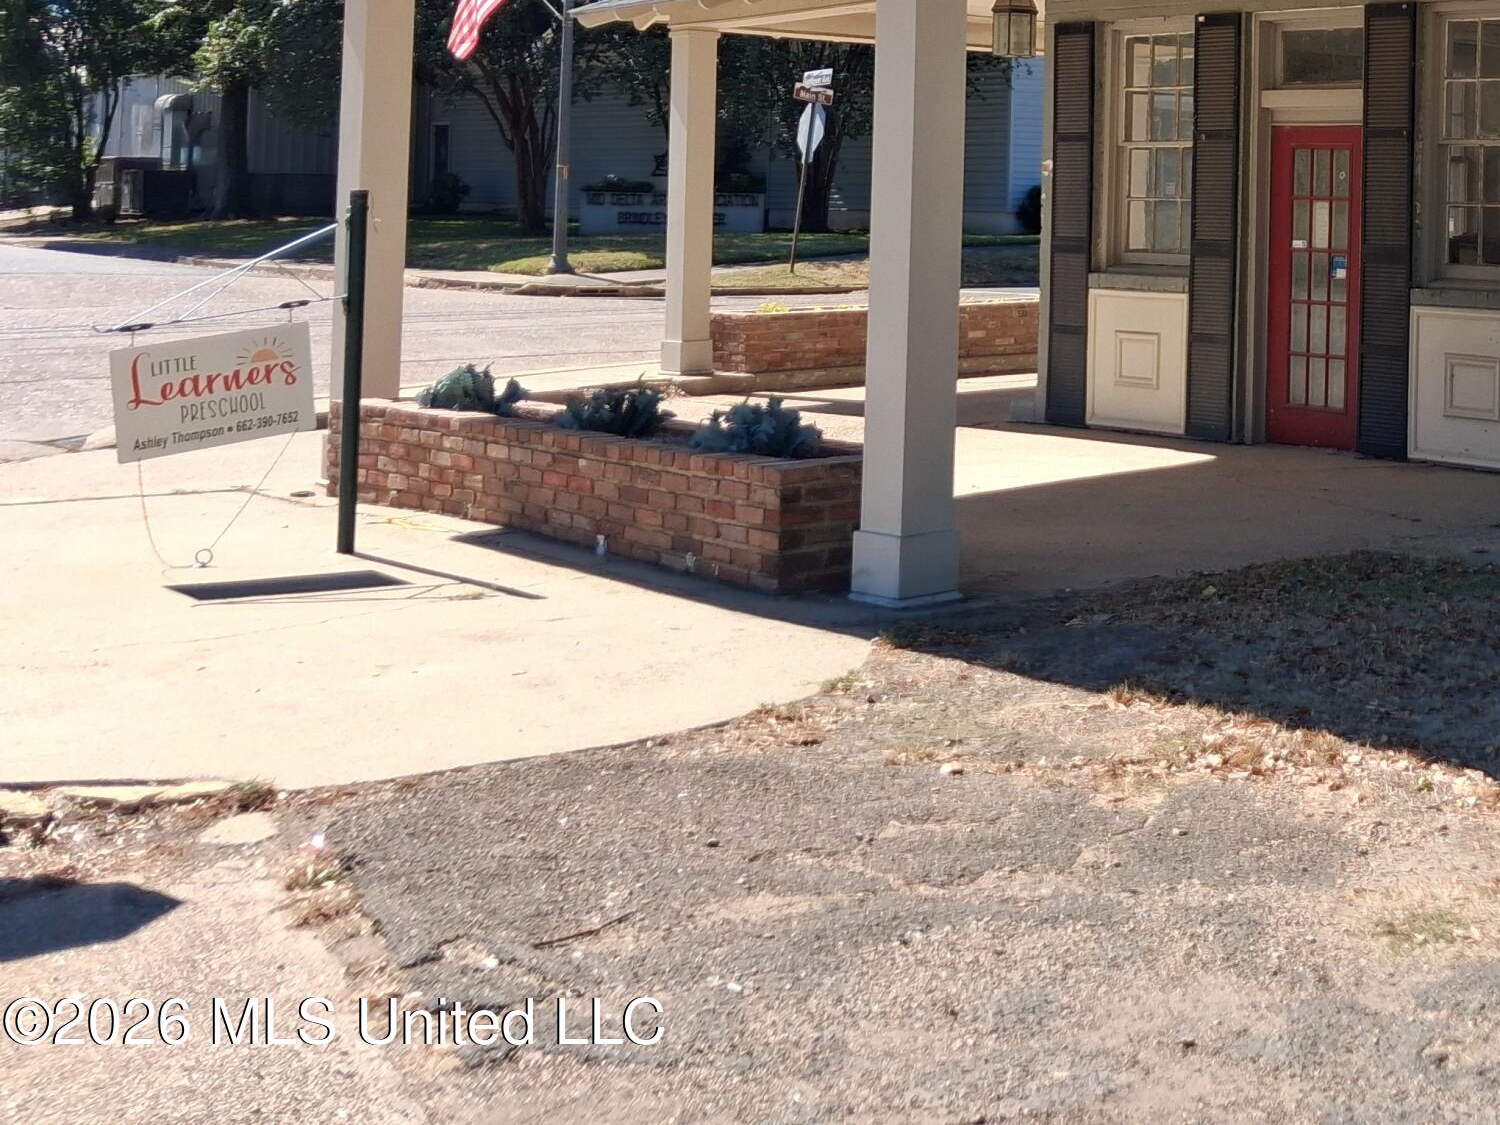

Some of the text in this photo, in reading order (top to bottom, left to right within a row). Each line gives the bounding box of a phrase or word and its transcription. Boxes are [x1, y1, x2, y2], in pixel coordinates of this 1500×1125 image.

[799, 89, 816, 101] Main
[127, 352, 302, 411] Learners
[151, 355, 198, 377] LITTLE
[180, 392, 266, 424] PRESCHOOL
[132, 410, 299, 451] Ashley Thompson 662-390-7652
